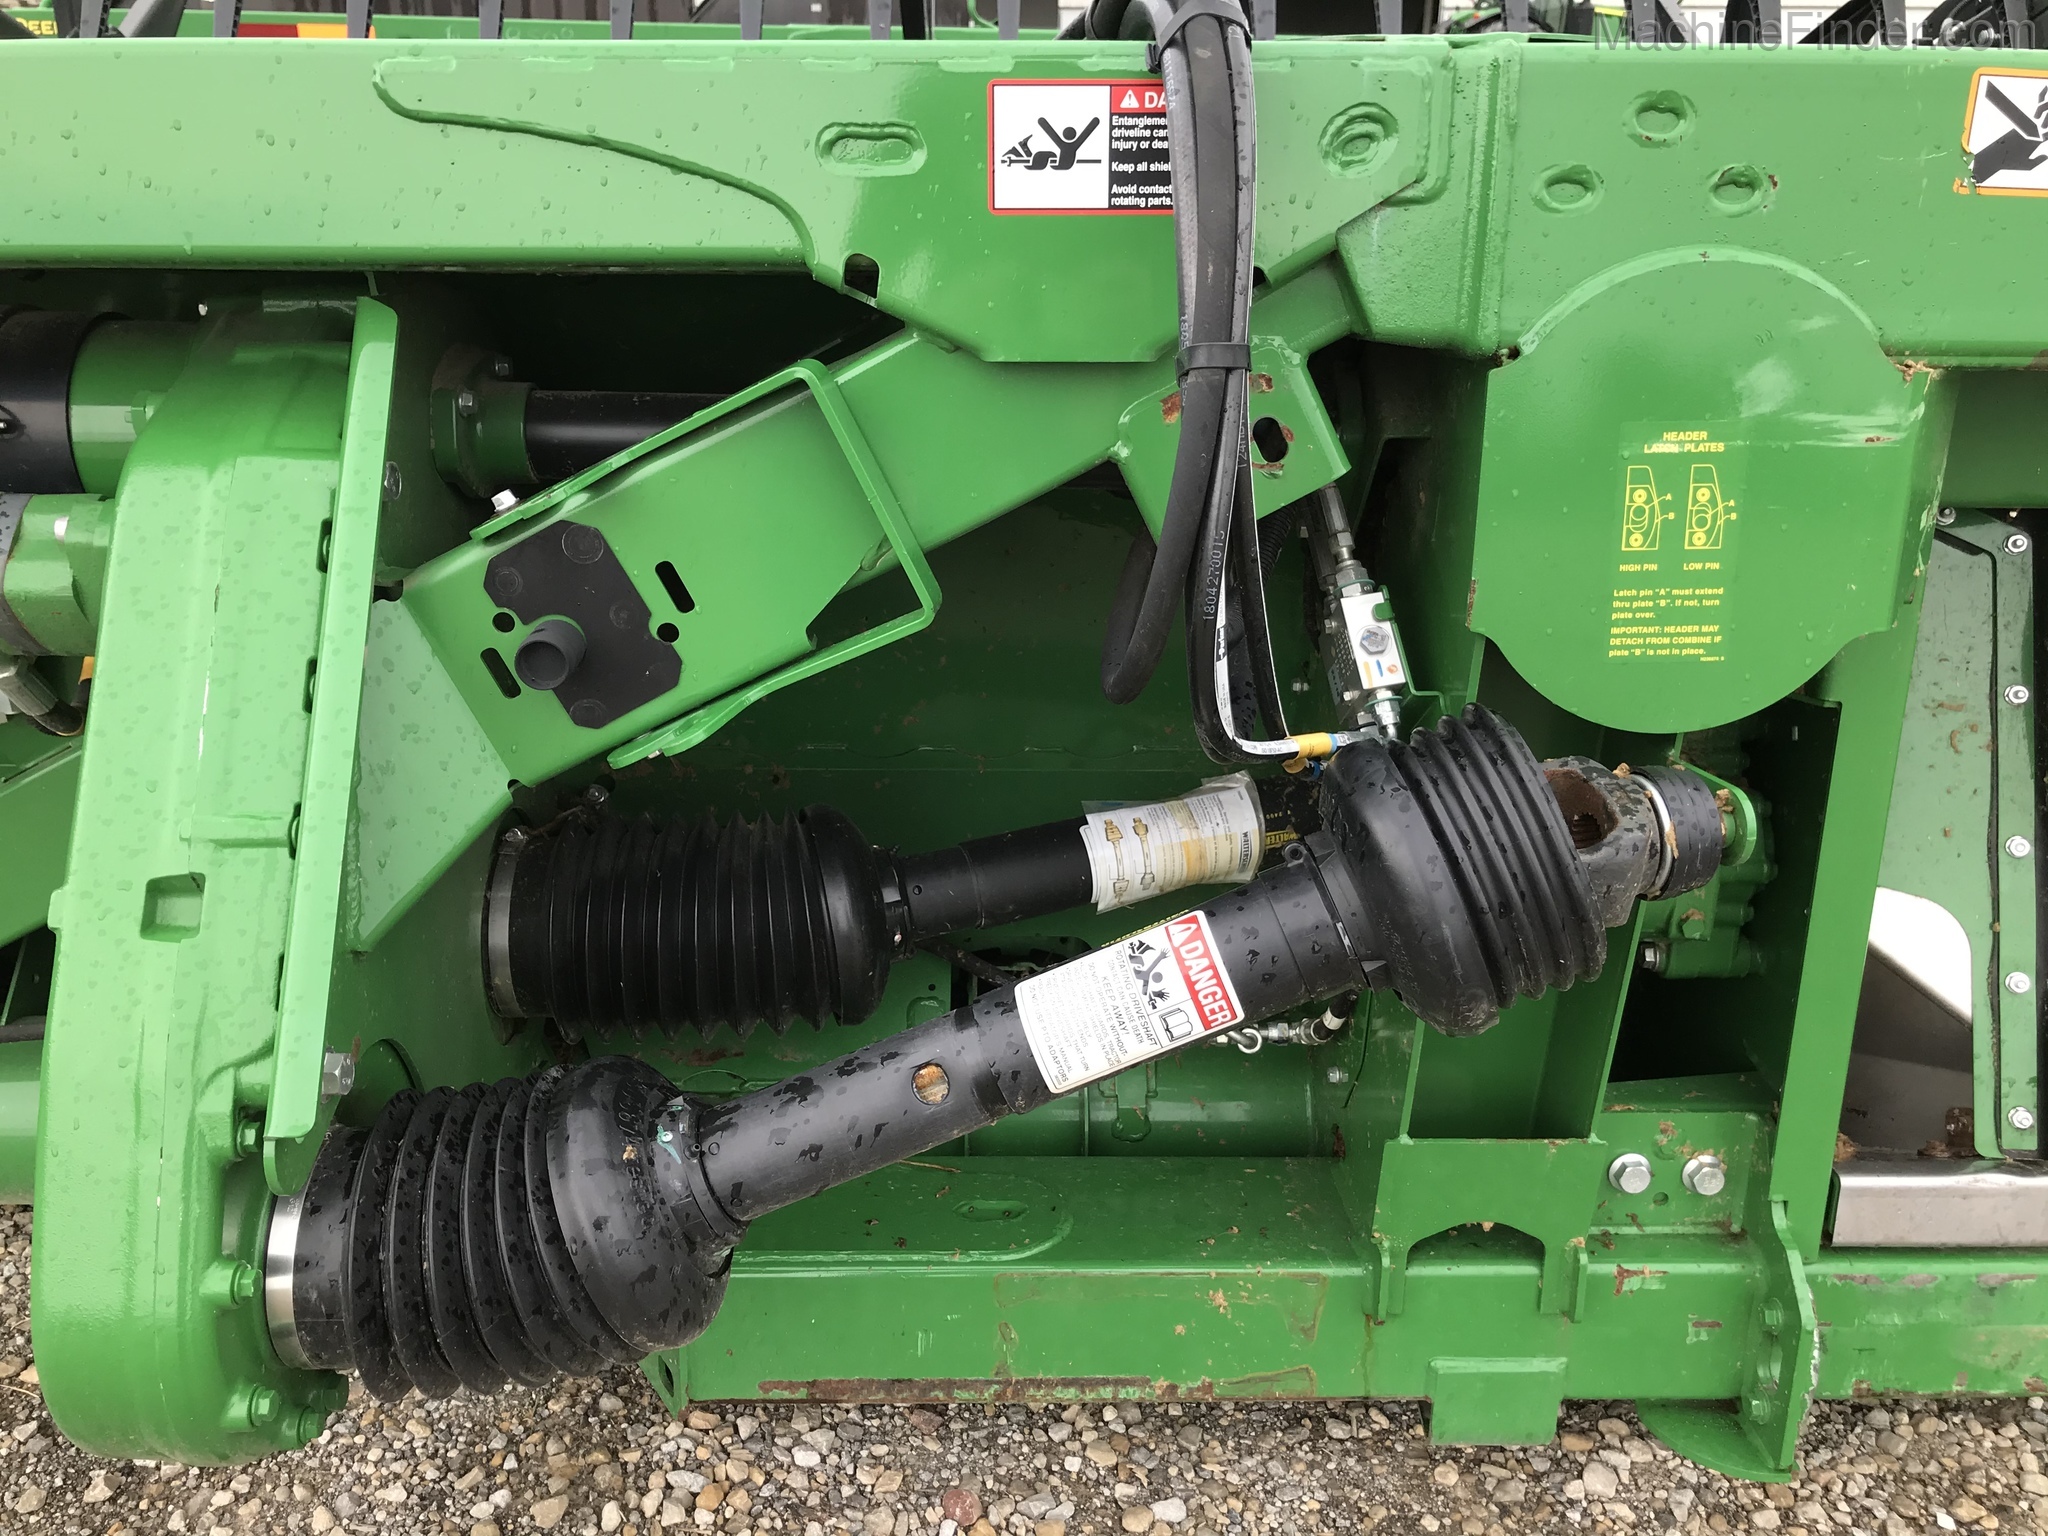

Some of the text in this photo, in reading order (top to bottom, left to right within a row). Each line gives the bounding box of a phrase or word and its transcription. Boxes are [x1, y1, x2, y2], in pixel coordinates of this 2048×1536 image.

[1112, 128, 1150, 137] driveline
[1112, 139, 1138, 151] injury
[1152, 140, 1168, 148] dea
[1112, 162, 1135, 173] Keep
[1137, 162, 1147, 171] all
[1111, 184, 1172, 194] Avoid contact
[1111, 196, 1173, 207] rotating parts.
[1663, 432, 1707, 441] HEADER
[1684, 443, 1724, 452] PLATES
[1611, 626, 1662, 634] IMPORTANT:
[1179, 940, 1231, 1027] DANGER
[1094, 986, 1113, 1022] OPERATE
[1100, 975, 1129, 1036] KEEP AWAY!
[1114, 948, 1157, 1047] ROTATING DRIVESHAFT
[1116, 985, 1125, 1000] CAN
[1121, 1000, 1135, 1024] CAUSE
[1131, 1024, 1144, 1044] DEATH
[1034, 1008, 1044, 1024] USE
[1040, 1026, 1051, 1042] PTO
[1047, 1044, 1068, 1082] ADAPTORS
[1076, 1028, 1088, 1047] ENDS
[1058, 1046, 1073, 1073] MANUAL
[1072, 1039, 1083, 1055] THAT
[1079, 1056, 1089, 1071] TURN
[1103, 1050, 1115, 1067] PLACE
[1106, 1040, 1121, 1064] TRACTOR
